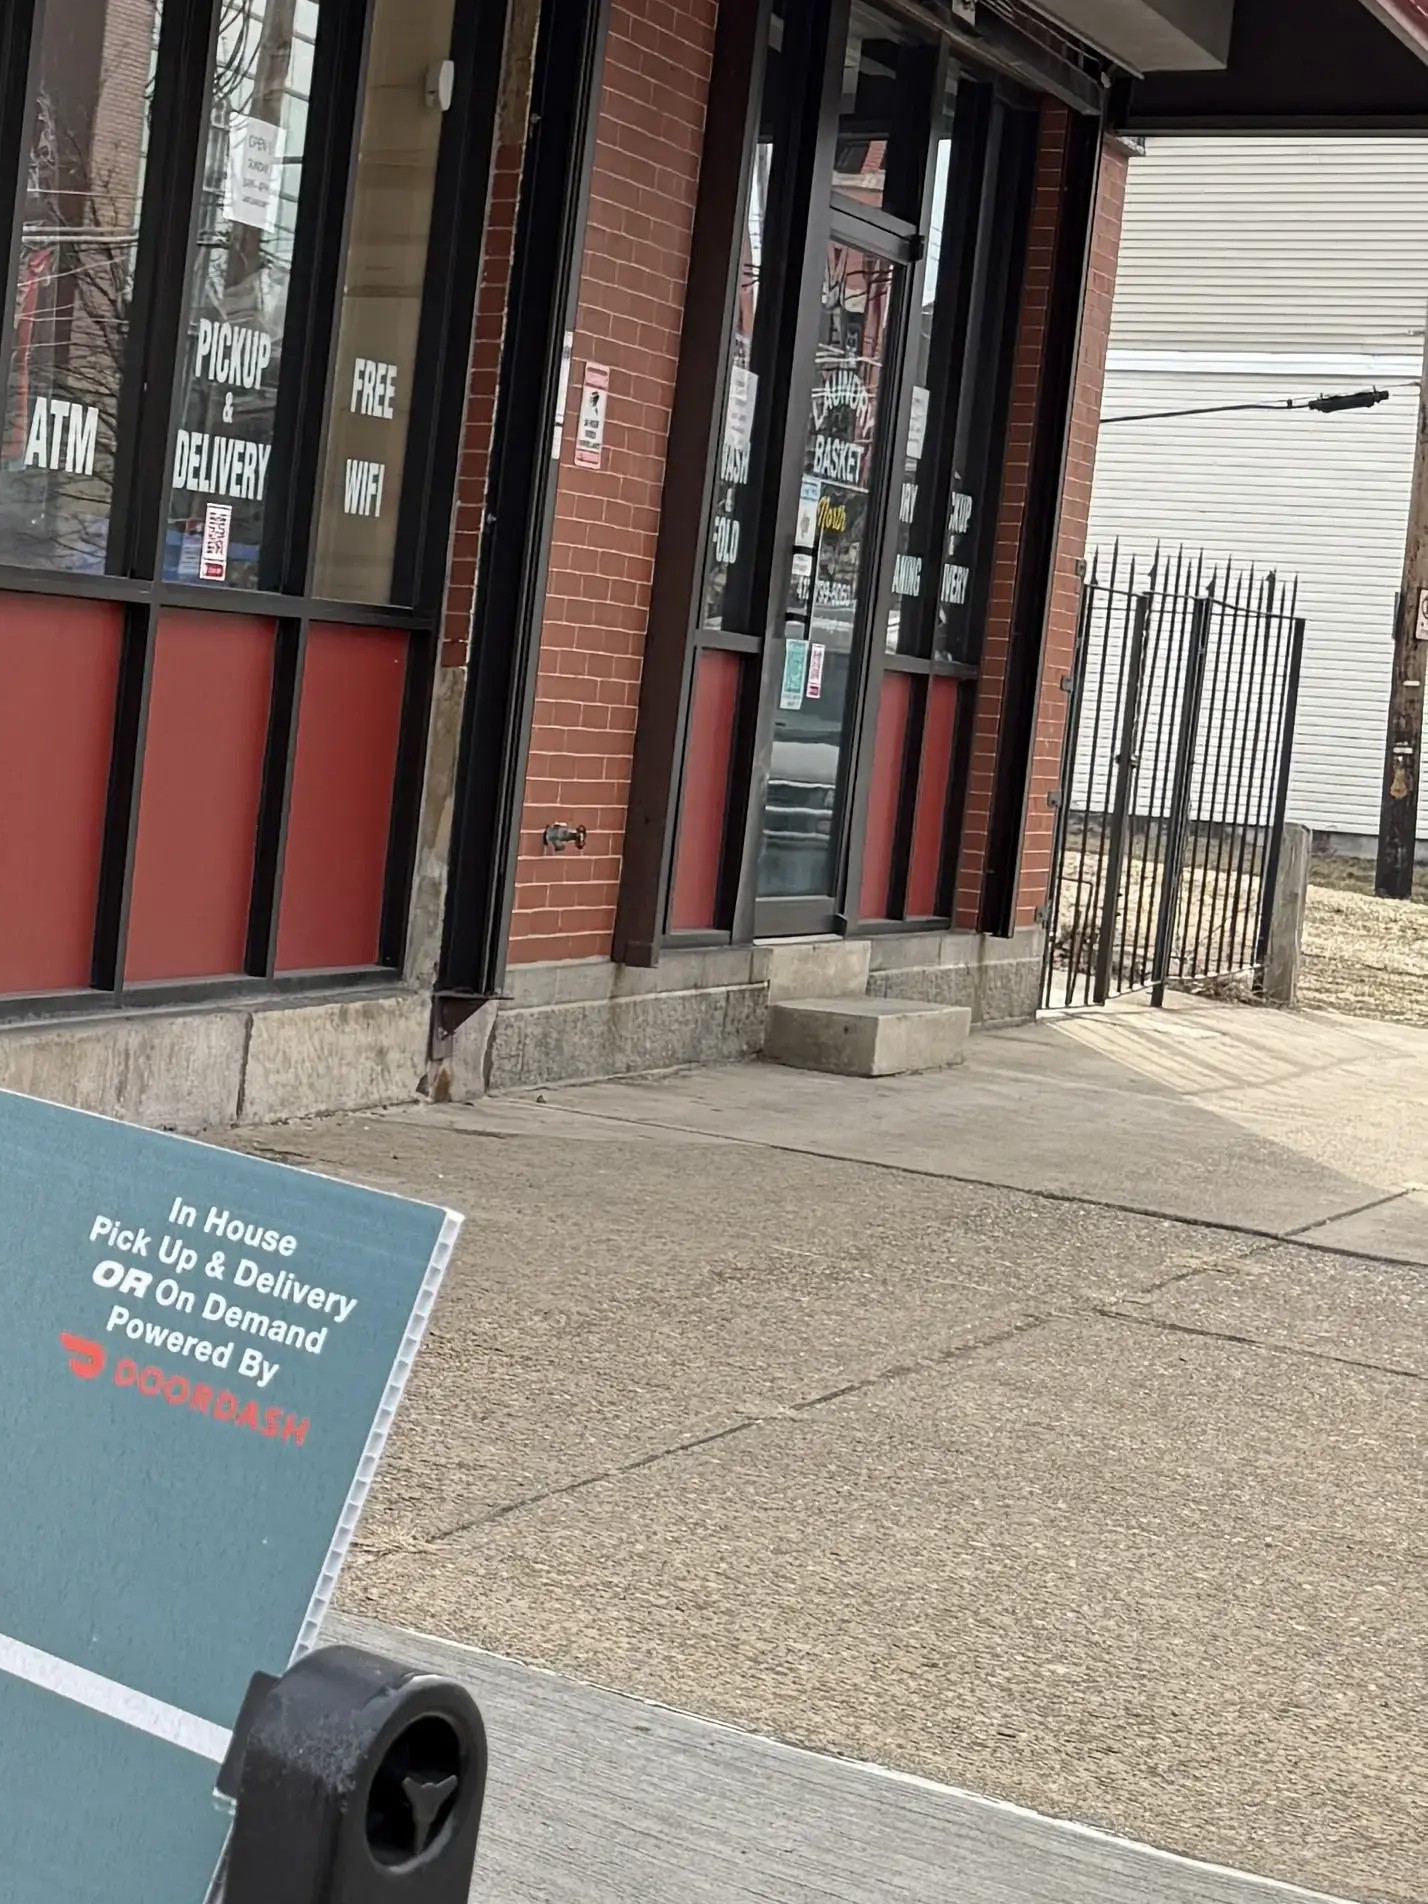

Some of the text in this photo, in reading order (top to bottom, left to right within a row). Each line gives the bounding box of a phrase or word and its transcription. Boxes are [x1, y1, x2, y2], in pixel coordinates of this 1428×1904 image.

[195, 318, 271, 390] PICKUP
[222, 392, 233, 423] &
[350, 358, 398, 419] FREE
[812, 371, 875, 436] LAUNDRY
[24, 397, 99, 476] ATM
[172, 429, 271, 501] DELIVERY
[813, 434, 864, 483] BASKET
[344, 459, 385, 517] WIFI
[817, 496, 846, 533] North
[168, 1196, 298, 1256] In House
[89, 1215, 359, 1323] Pick Up & Delivery
[92, 1260, 328, 1355] OR On Demand
[106, 1305, 280, 1387] Powered By
[113, 1358, 311, 1447] DOORDASH
